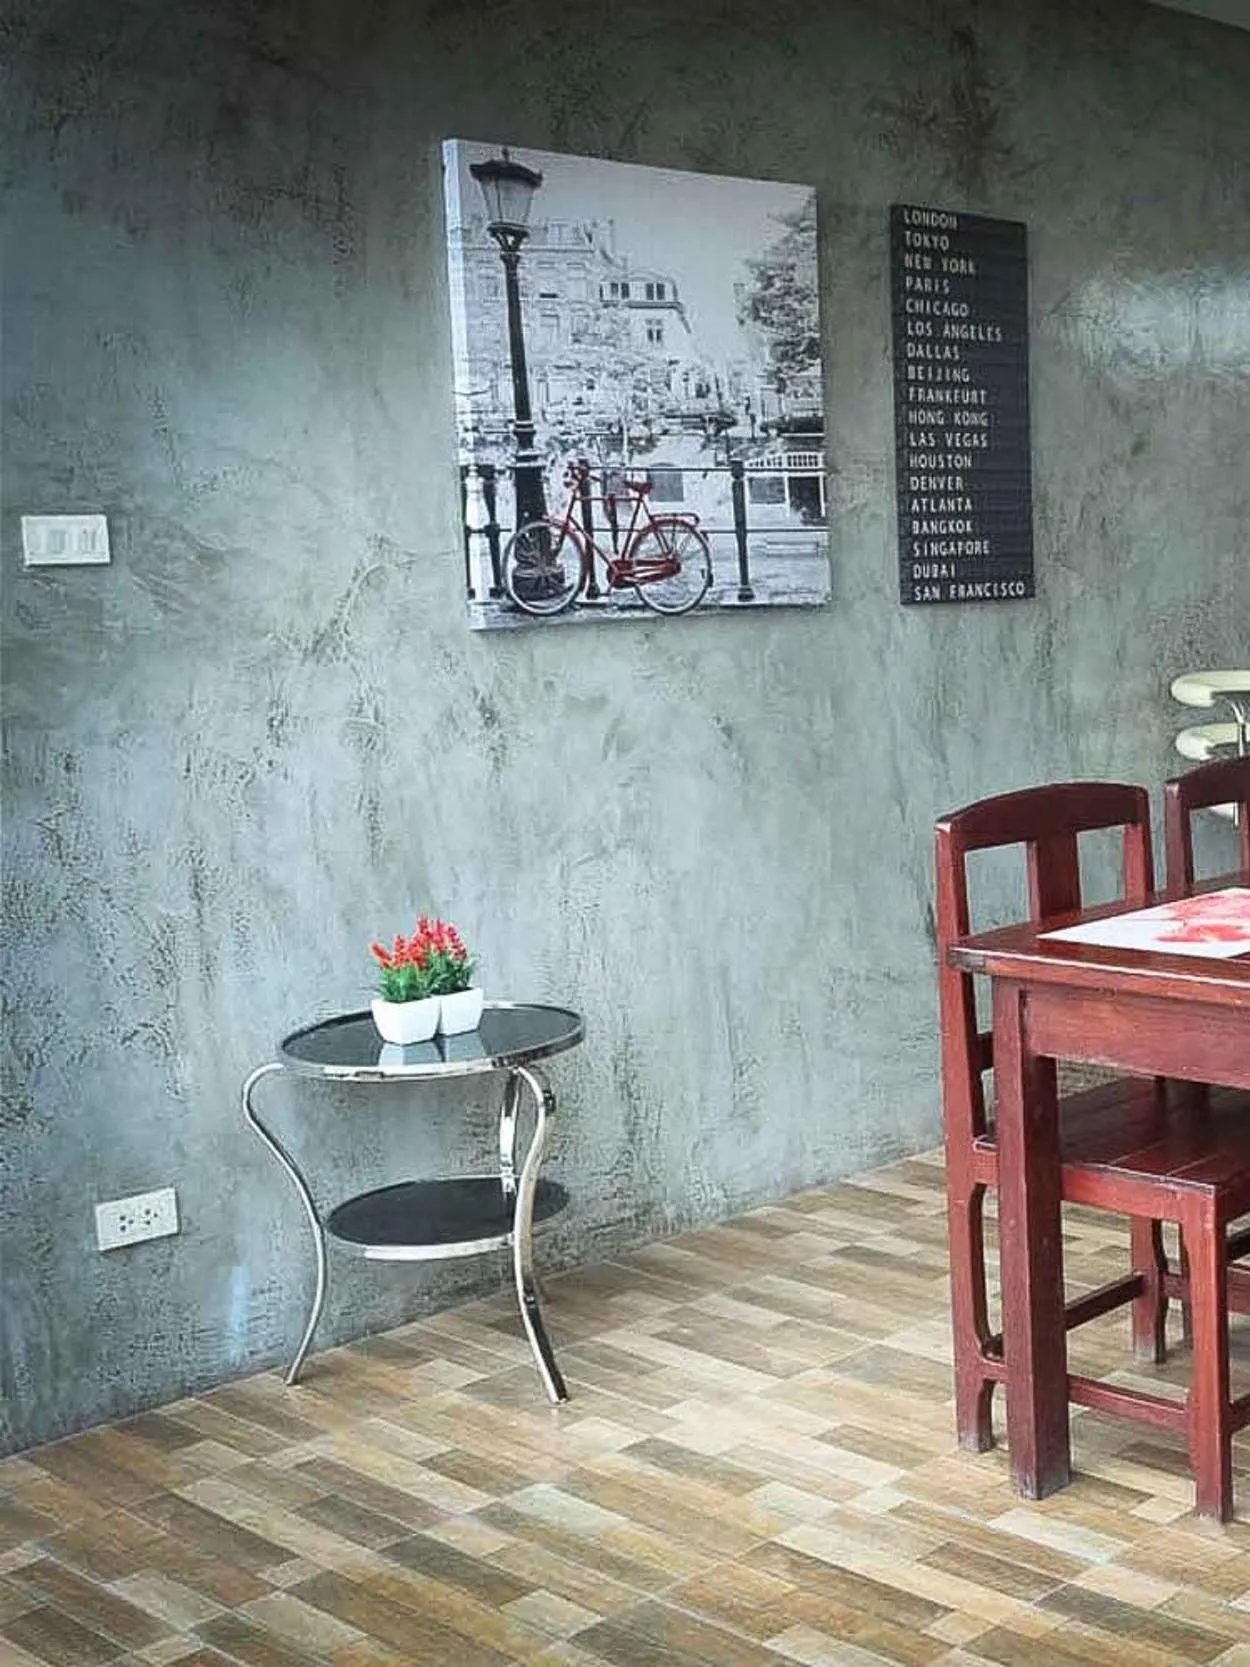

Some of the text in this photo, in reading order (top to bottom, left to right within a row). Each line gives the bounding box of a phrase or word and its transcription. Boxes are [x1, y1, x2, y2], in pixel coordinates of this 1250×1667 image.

[904, 208, 957, 230] LONDON
[905, 231, 949, 250] TOKYO
[904, 253, 976, 275] NEW YORK
[906, 276, 950, 294] PARIS
[906, 298, 969, 317] CHICAGO
[907, 321, 1002, 342] LOS ANGELES
[906, 342, 960, 360] DALLAS
[908, 365, 970, 382] BEIJING
[908, 387, 987, 404] FRANKFURT
[908, 410, 989, 427] HONG KONG
[909, 432, 988, 448] LAS VEGAS
[909, 454, 972, 468] HOUSTON
[910, 476, 964, 491] DENVER
[911, 498, 973, 513] ATLANTA
[912, 520, 973, 534] BANGKOK
[913, 540, 990, 557] SINGAPORE
[913, 564, 956, 579] DUBAI
[914, 581, 1025, 601] SAN FRANCISCO
